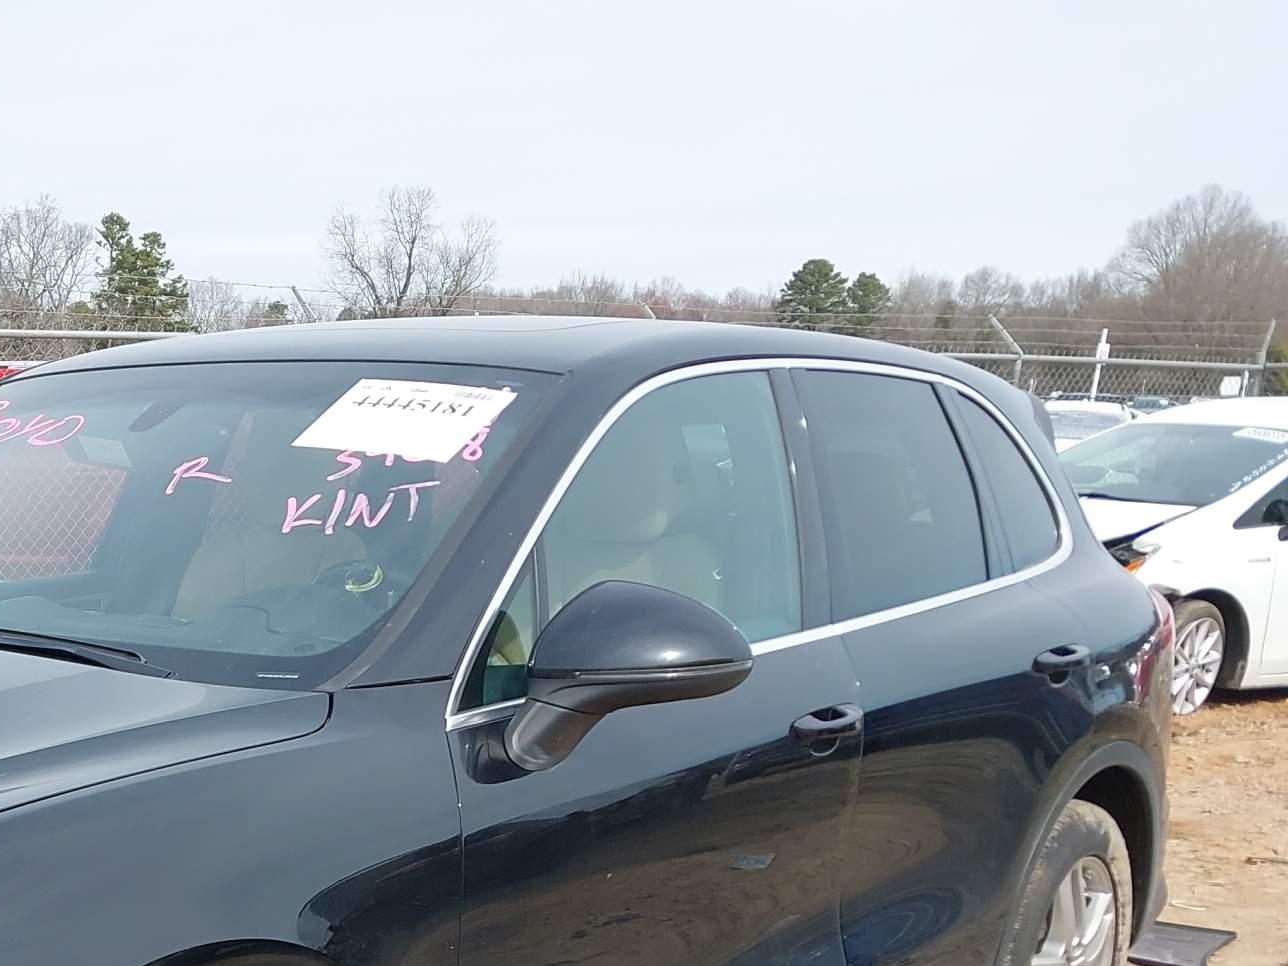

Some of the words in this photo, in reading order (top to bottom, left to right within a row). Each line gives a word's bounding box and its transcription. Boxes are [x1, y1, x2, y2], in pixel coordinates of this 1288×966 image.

[351, 395, 475, 417] 44445181
[165, 456, 233, 495] R
[281, 480, 441, 535] KINT
